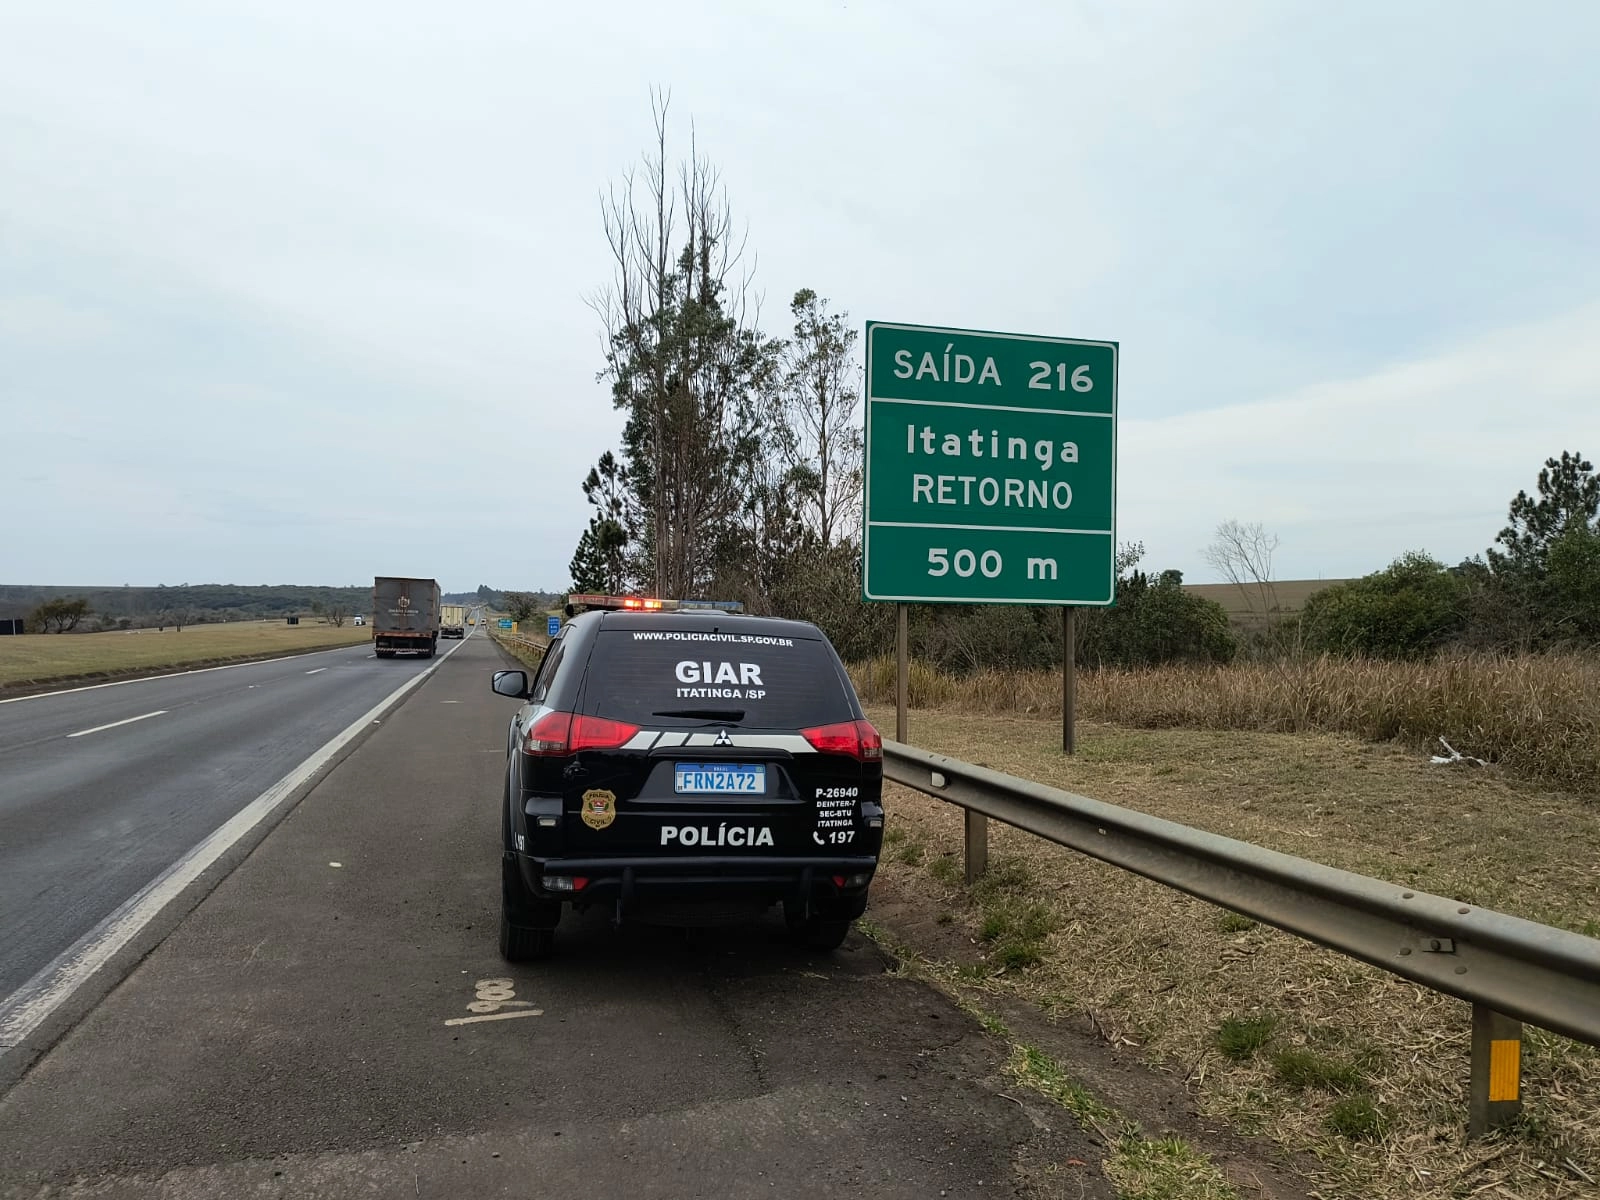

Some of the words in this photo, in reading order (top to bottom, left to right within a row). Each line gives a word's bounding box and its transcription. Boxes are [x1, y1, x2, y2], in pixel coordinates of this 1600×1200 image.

[893, 343, 1002, 386] SAÍDA
[1028, 361, 1094, 393] 216
[907, 424, 1079, 471] Itatinga
[912, 473, 1073, 510] RETORNO
[927, 548, 1003, 578] 500
[1027, 556, 1058, 580] m
[633, 632, 793, 648] WWW.POLICIACIVIL.SP.GOV.BR
[675, 660, 764, 686] GIAR
[676, 688, 742, 699] ITATINGA
[683, 772, 756, 790] FRN2A72
[815, 787, 858, 799] P-26940
[816, 800, 856, 808] DEINTER-7
[817, 819, 853, 828] ITATINGA
[660, 822, 775, 847] POLÍCIA
[829, 831, 856, 844] 197
